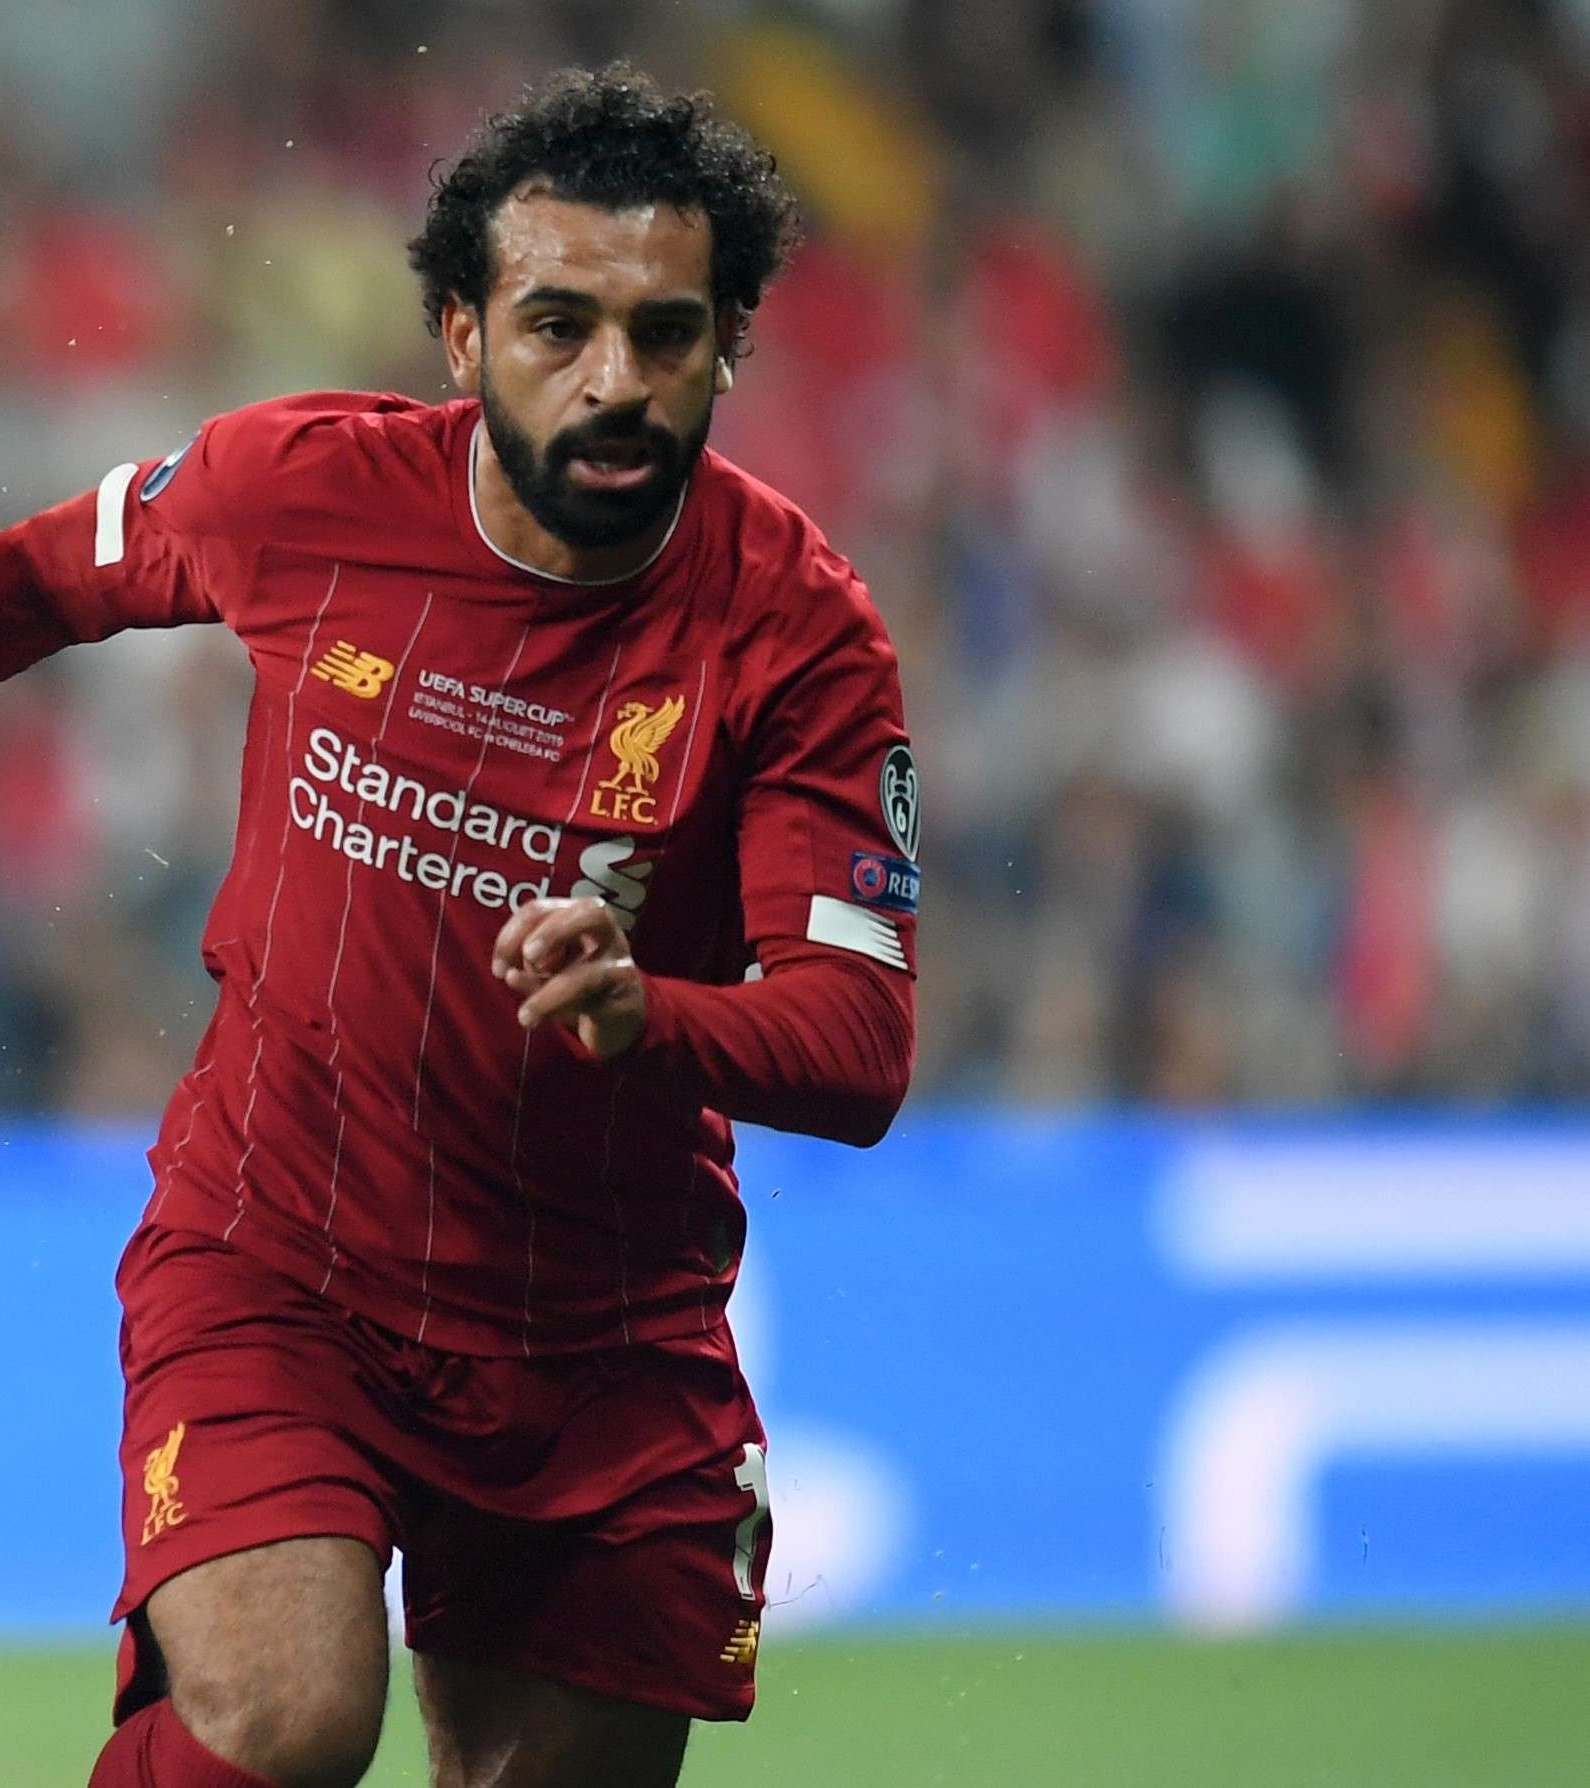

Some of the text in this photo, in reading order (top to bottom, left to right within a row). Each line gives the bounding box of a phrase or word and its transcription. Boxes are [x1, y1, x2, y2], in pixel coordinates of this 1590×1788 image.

[419, 669, 465, 699] UEFA
[469, 686, 526, 717] SUPER
[304, 727, 563, 864] Standard
[895, 803, 907, 832] 6
[289, 777, 552, 914] Chartered
